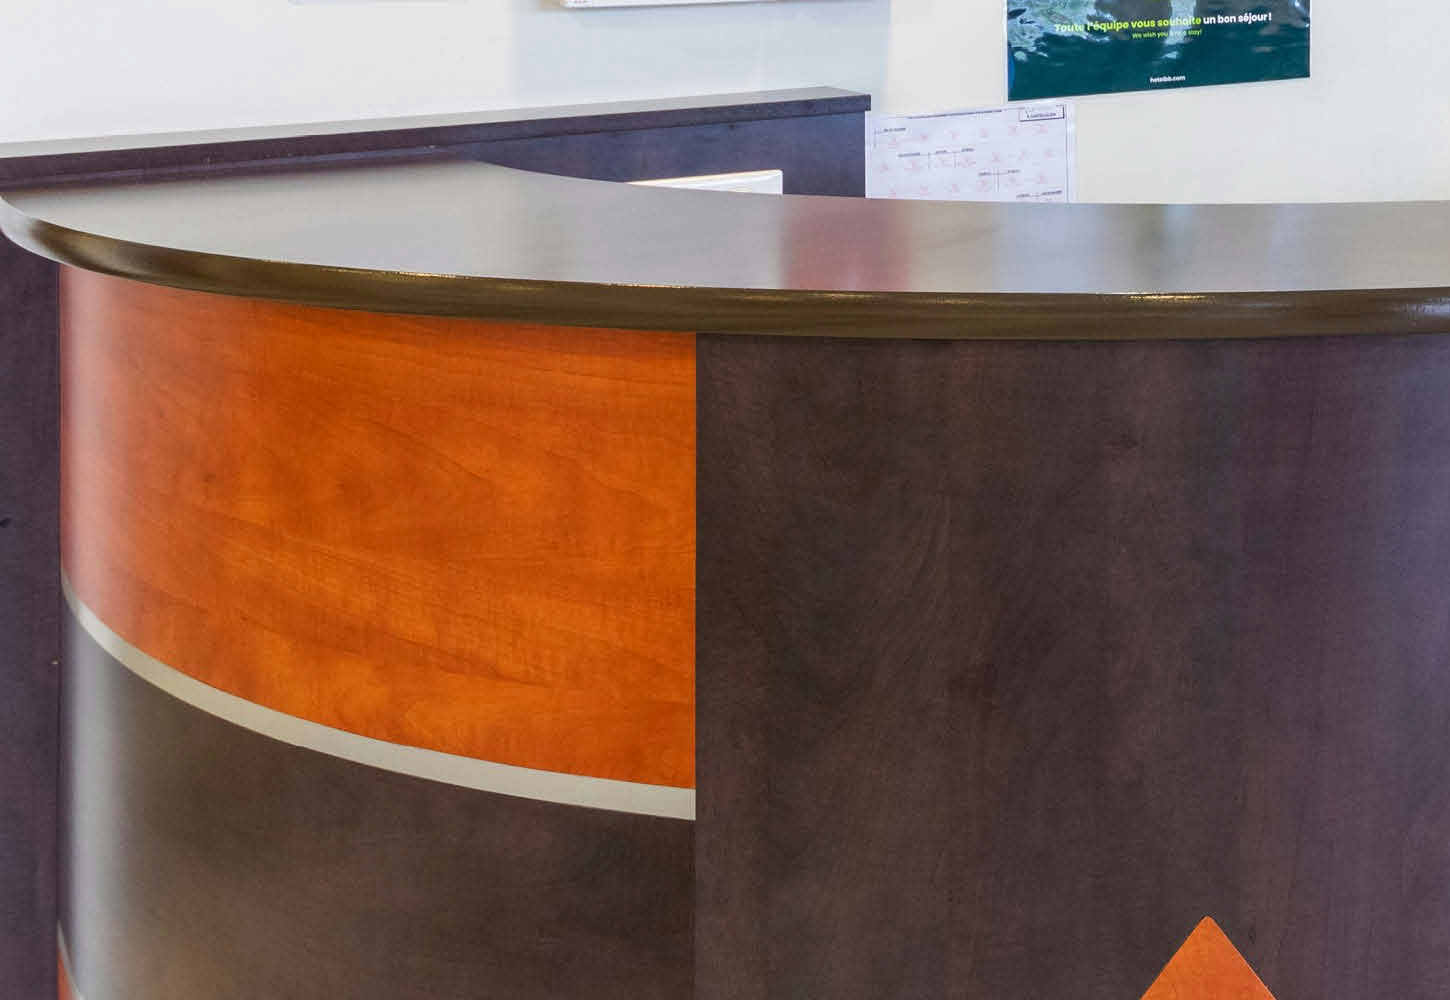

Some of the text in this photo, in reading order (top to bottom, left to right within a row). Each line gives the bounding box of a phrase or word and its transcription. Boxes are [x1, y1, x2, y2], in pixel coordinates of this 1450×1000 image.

[1054, 23, 1085, 33] Toute
[1087, 20, 1129, 33] l'équipe
[1131, 18, 1155, 29] vous
[1157, 16, 1202, 28] souhaite
[1203, 15, 1216, 25] un
[1217, 14, 1236, 24] bon
